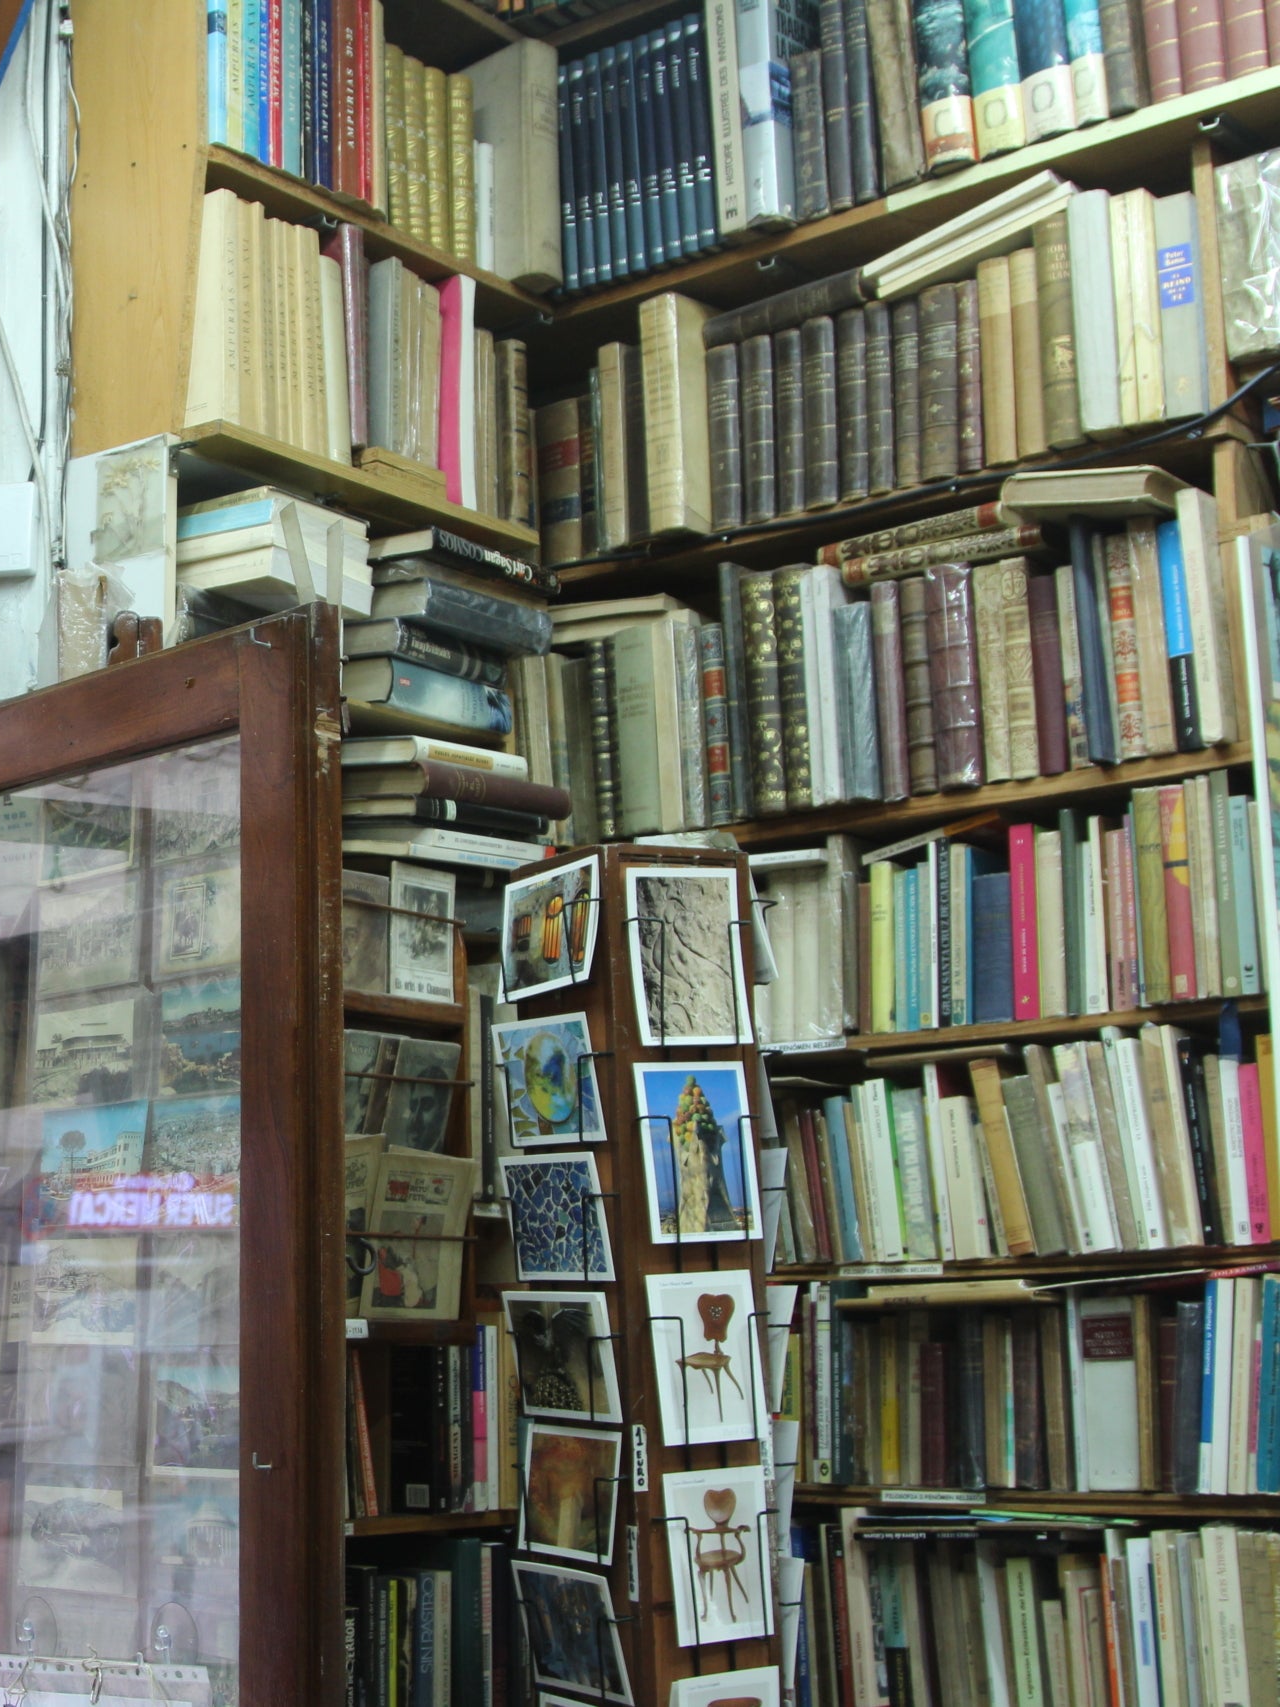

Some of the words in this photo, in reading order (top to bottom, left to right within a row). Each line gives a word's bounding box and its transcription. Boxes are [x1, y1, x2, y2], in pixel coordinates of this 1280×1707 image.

[345, 27, 353, 57] 31-32
[716, 3, 726, 63] INVENTIONS
[232, 21, 240, 92] AMPURIAS
[247, 37, 256, 107] AMPURIAS
[288, 44, 296, 122] AMPURIAS
[720, 66, 728, 86] DES
[346, 68, 355, 148] AMPURIAS
[726, 141, 734, 185] HISTOIRE
[1163, 276, 1191, 290] REINO
[227, 287, 236, 370] AMPURIAS
[243, 300, 251, 376] AMPURIAS
[279, 301, 287, 383] AMPURIAS
[306, 327, 314, 400] AMPURIAS
[439, 530, 485, 563] COSMOS
[484, 549, 513, 574] Sagan
[512, 559, 533, 582] Carl
[939, 851, 948, 904] CARAVACA
[940, 903, 948, 918] DE
[941, 920, 949, 948] CRUZ
[941, 948, 949, 985] SANTA
[942, 984, 950, 1016] GRAN
[634, 1427, 643, 1446] 1
[635, 1451, 645, 1487] EURO
[421, 1647, 434, 1674] SIN
